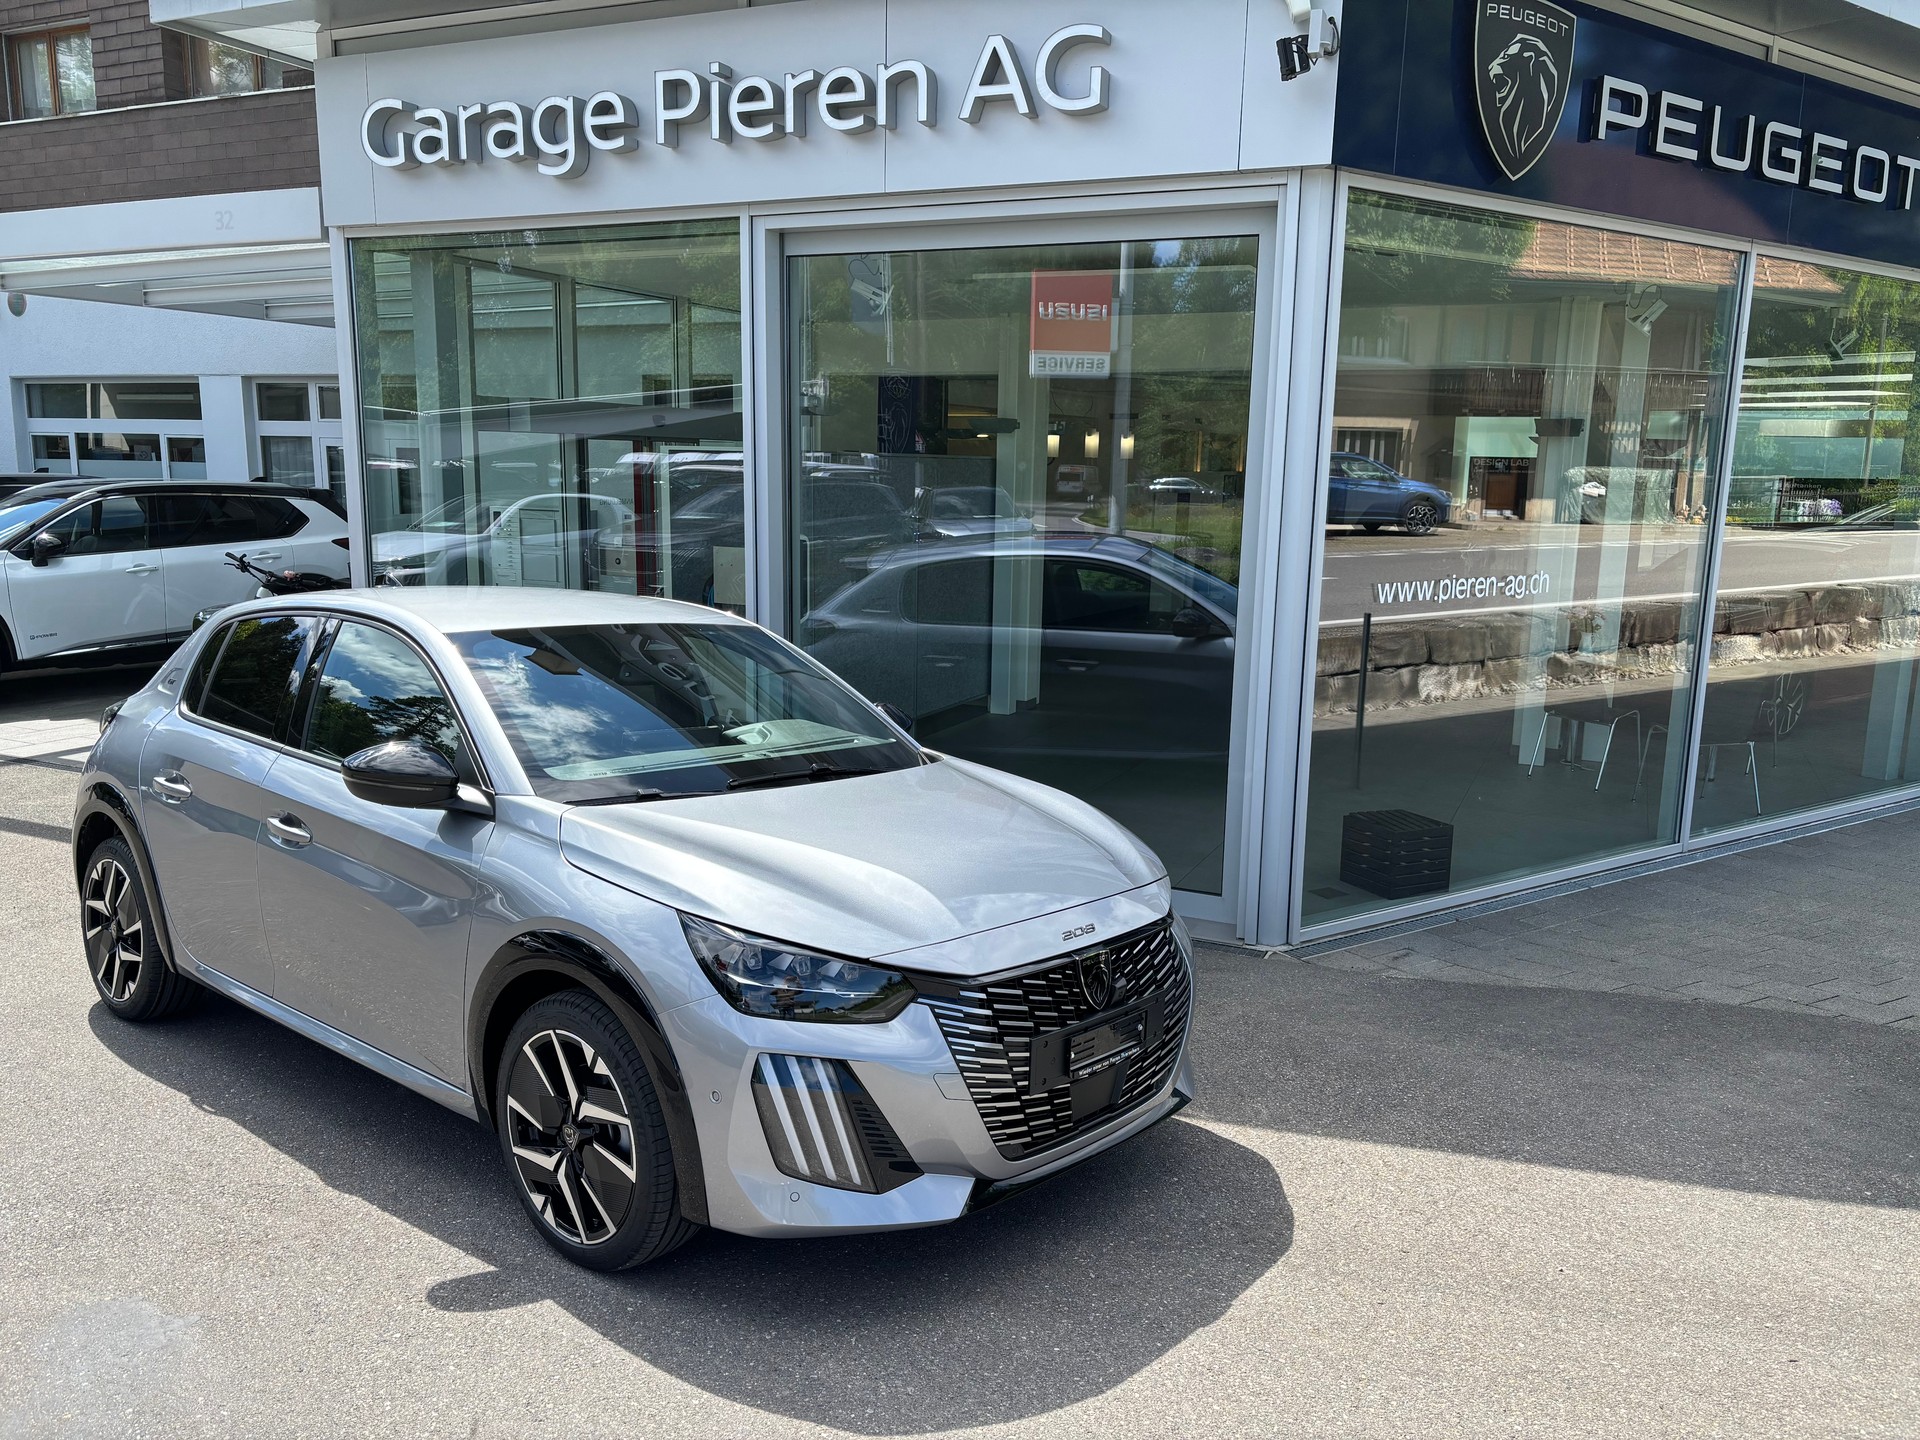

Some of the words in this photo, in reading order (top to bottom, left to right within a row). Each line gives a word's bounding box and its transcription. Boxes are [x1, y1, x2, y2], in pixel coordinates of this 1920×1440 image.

[1486, 3, 1569, 38] PEUGEOT
[360, 91, 640, 179] Garage
[654, 59, 938, 149] Pieren
[957, 23, 1112, 123] AG
[1594, 73, 1920, 212] PEUGEOT
[214, 210, 234, 230] 32
[1474, 458, 1508, 467] DESIGN
[1511, 459, 1530, 467] LAB
[1377, 570, 1550, 604] www.pieren-ag.ch
[1062, 923, 1096, 941] 208
